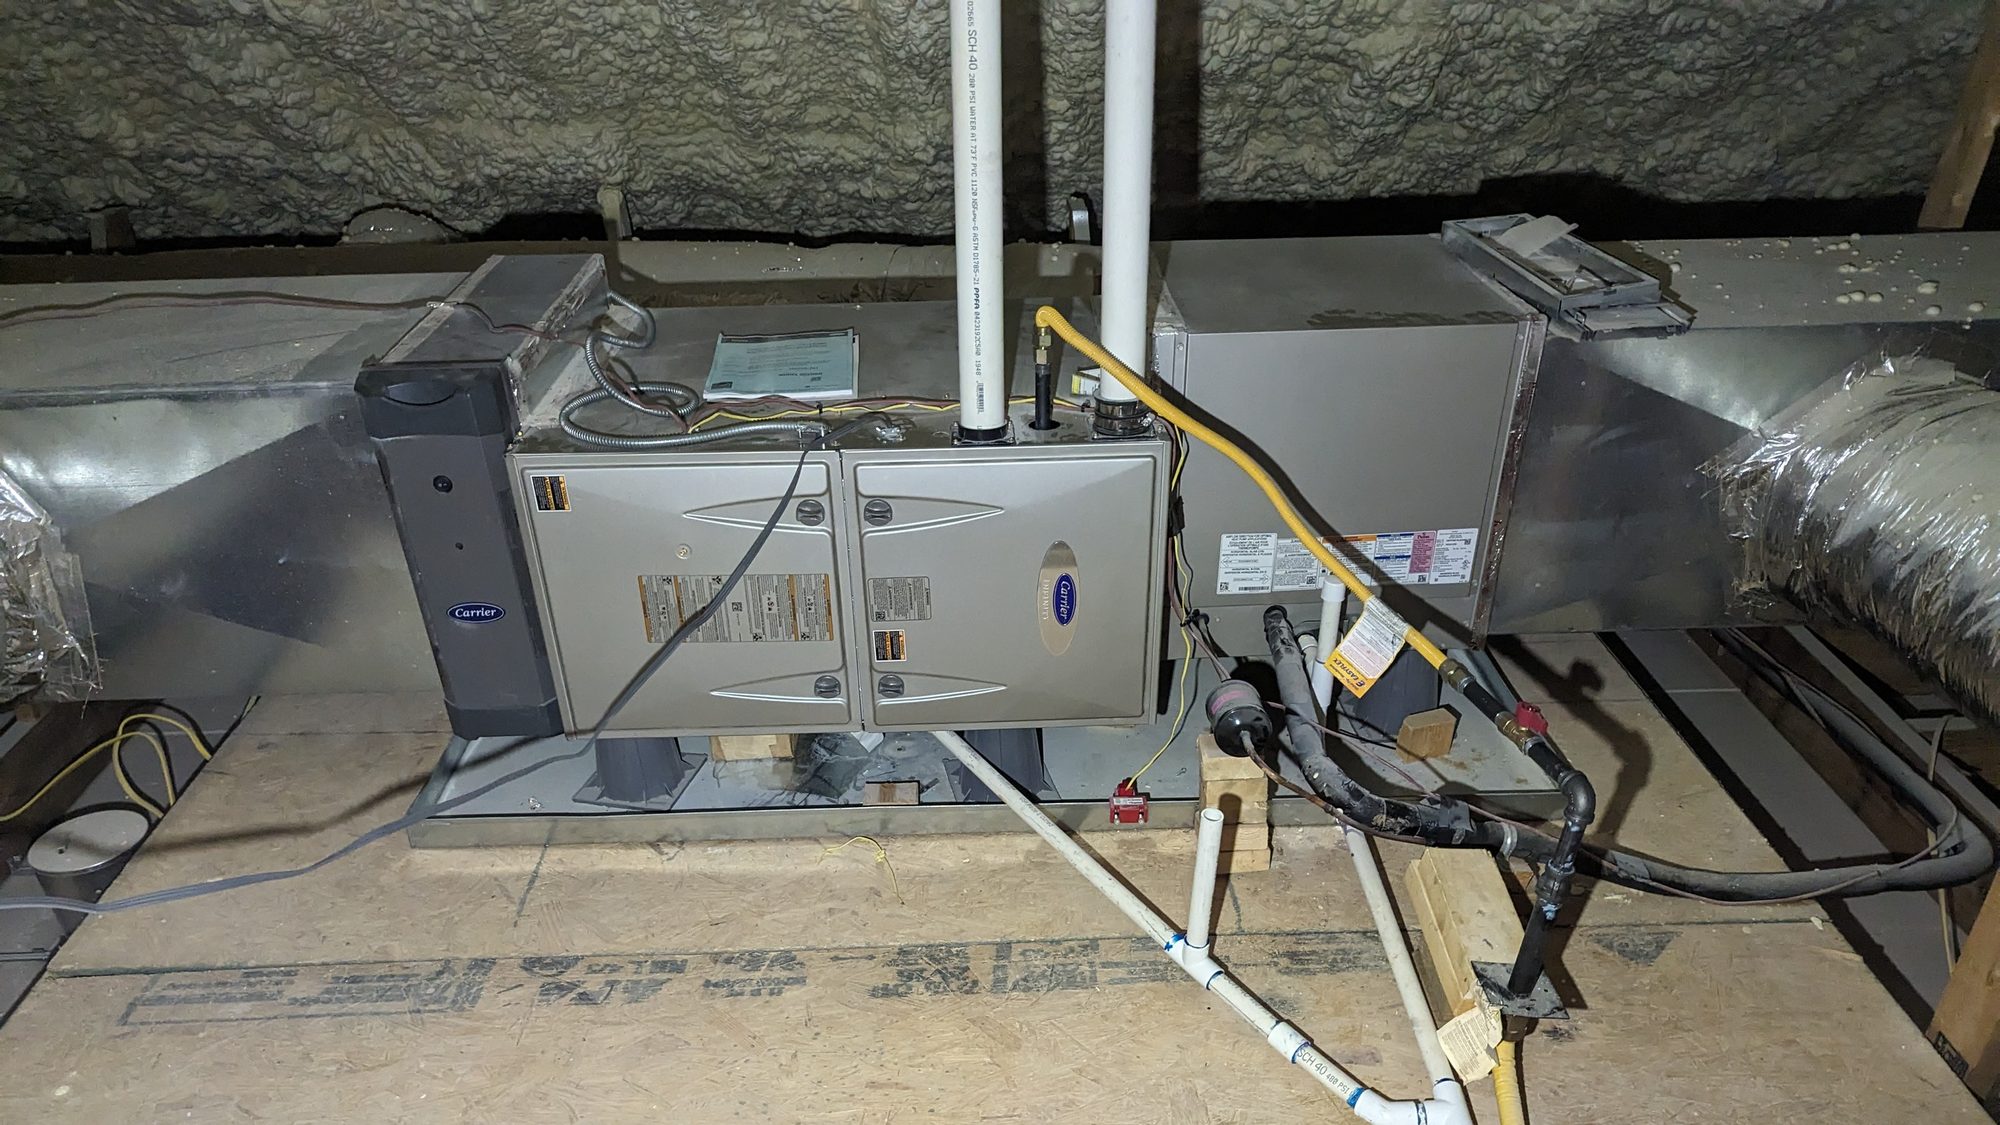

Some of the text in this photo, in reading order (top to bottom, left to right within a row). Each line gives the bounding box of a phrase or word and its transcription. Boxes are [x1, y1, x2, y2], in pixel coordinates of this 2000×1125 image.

[967, 29, 977, 53] SCH
[968, 54, 978, 71] 40
[968, 73, 976, 89] 280
[969, 106, 977, 131] WATER
[970, 132, 977, 143] AT
[970, 162, 978, 178] PVC
[971, 179, 979, 197] 1120
[972, 232, 980, 251] ASTM
[973, 287, 981, 310] PPFA
[1060, 580, 1071, 620] Carrier
[455, 607, 497, 618] Carrier
[1332, 657, 1359, 681] EASYFLEX
[1297, 1048, 1317, 1066] SCH
[1314, 1062, 1328, 1076] 40
[1336, 1081, 1350, 1094] PSI
